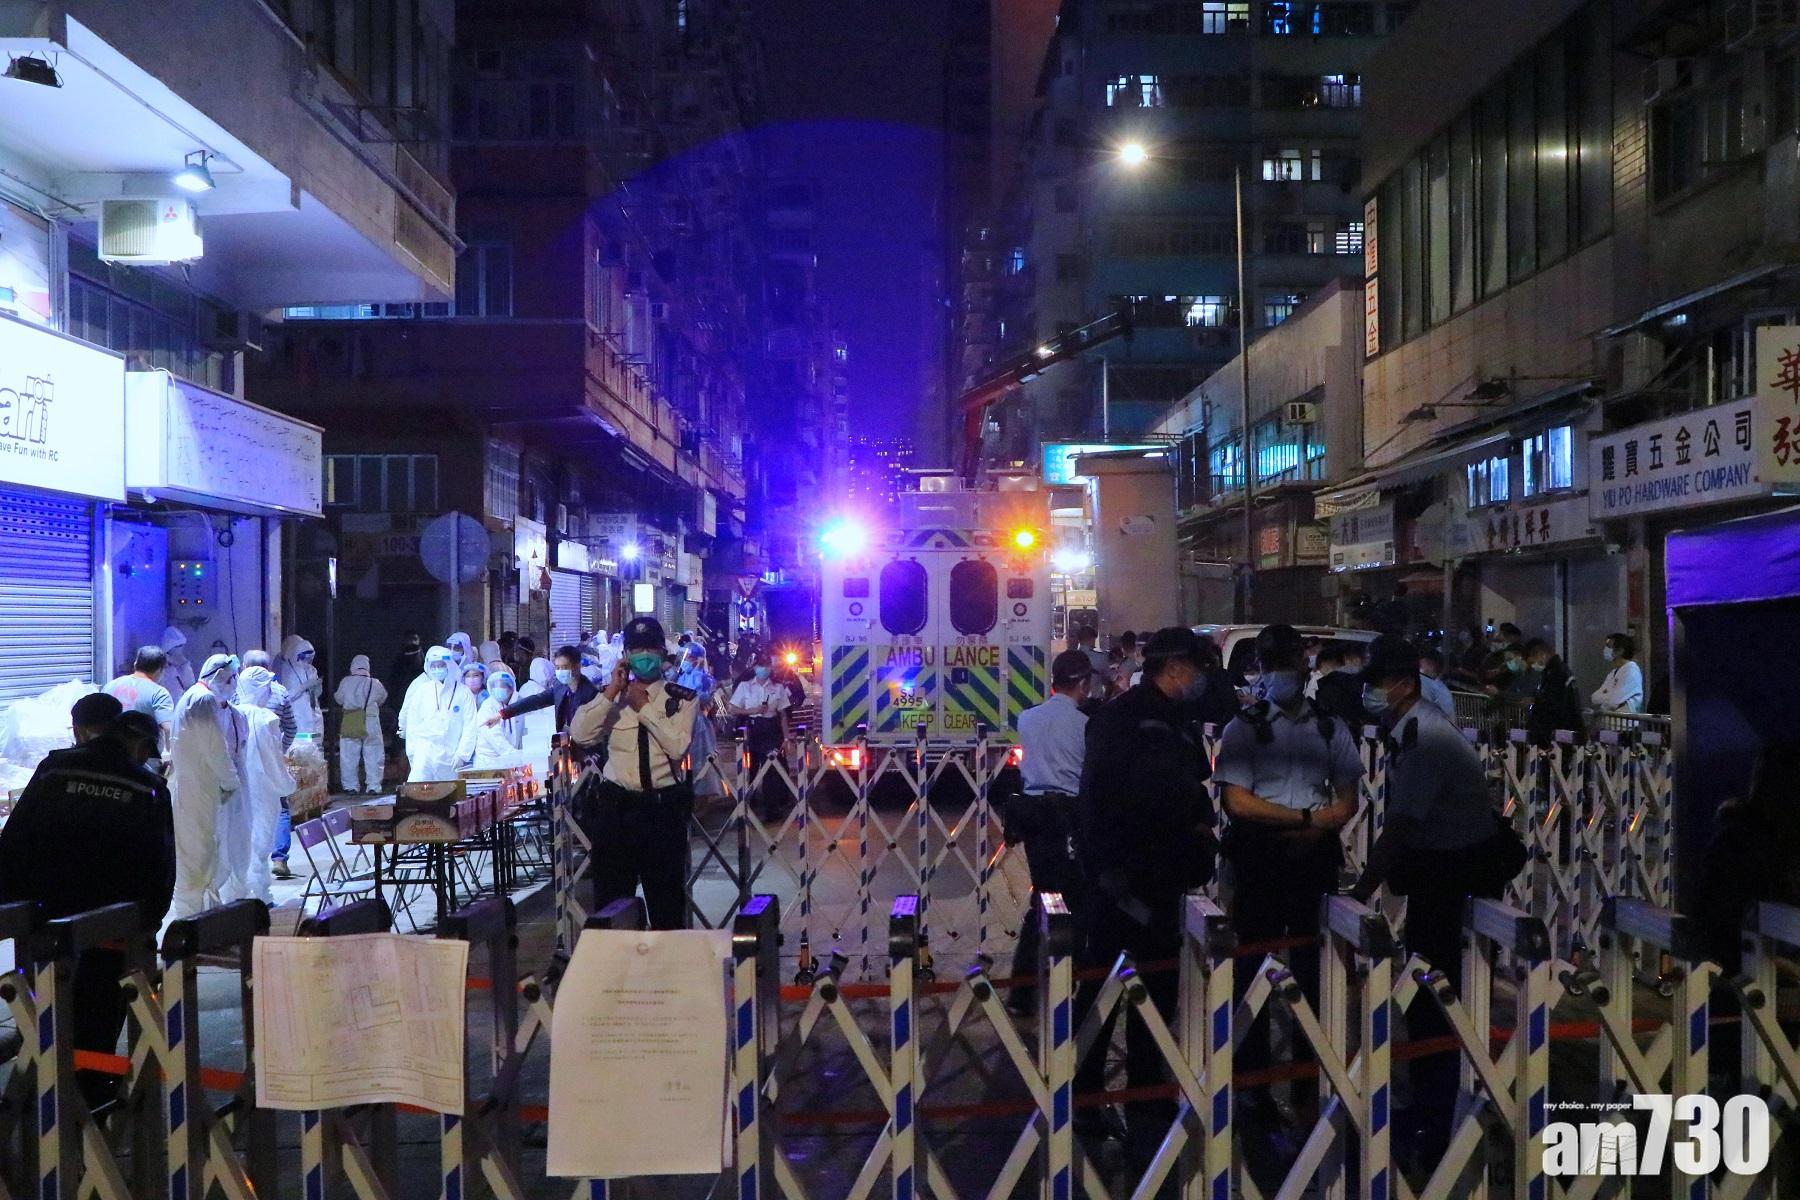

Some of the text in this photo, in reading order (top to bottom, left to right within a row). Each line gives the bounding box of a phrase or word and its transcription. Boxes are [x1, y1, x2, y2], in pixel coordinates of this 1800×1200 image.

[14, 442, 28, 456] Fun
[31, 448, 46, 460] with
[48, 450, 59, 462] RC
[1602, 462, 1752, 510] YIU PO HARDWARE COMPANY
[900, 688, 915, 698] SJ
[892, 697, 923, 707] 4995
[902, 713, 977, 729] KEEP CLEAR
[77, 783, 120, 800] POLICE
